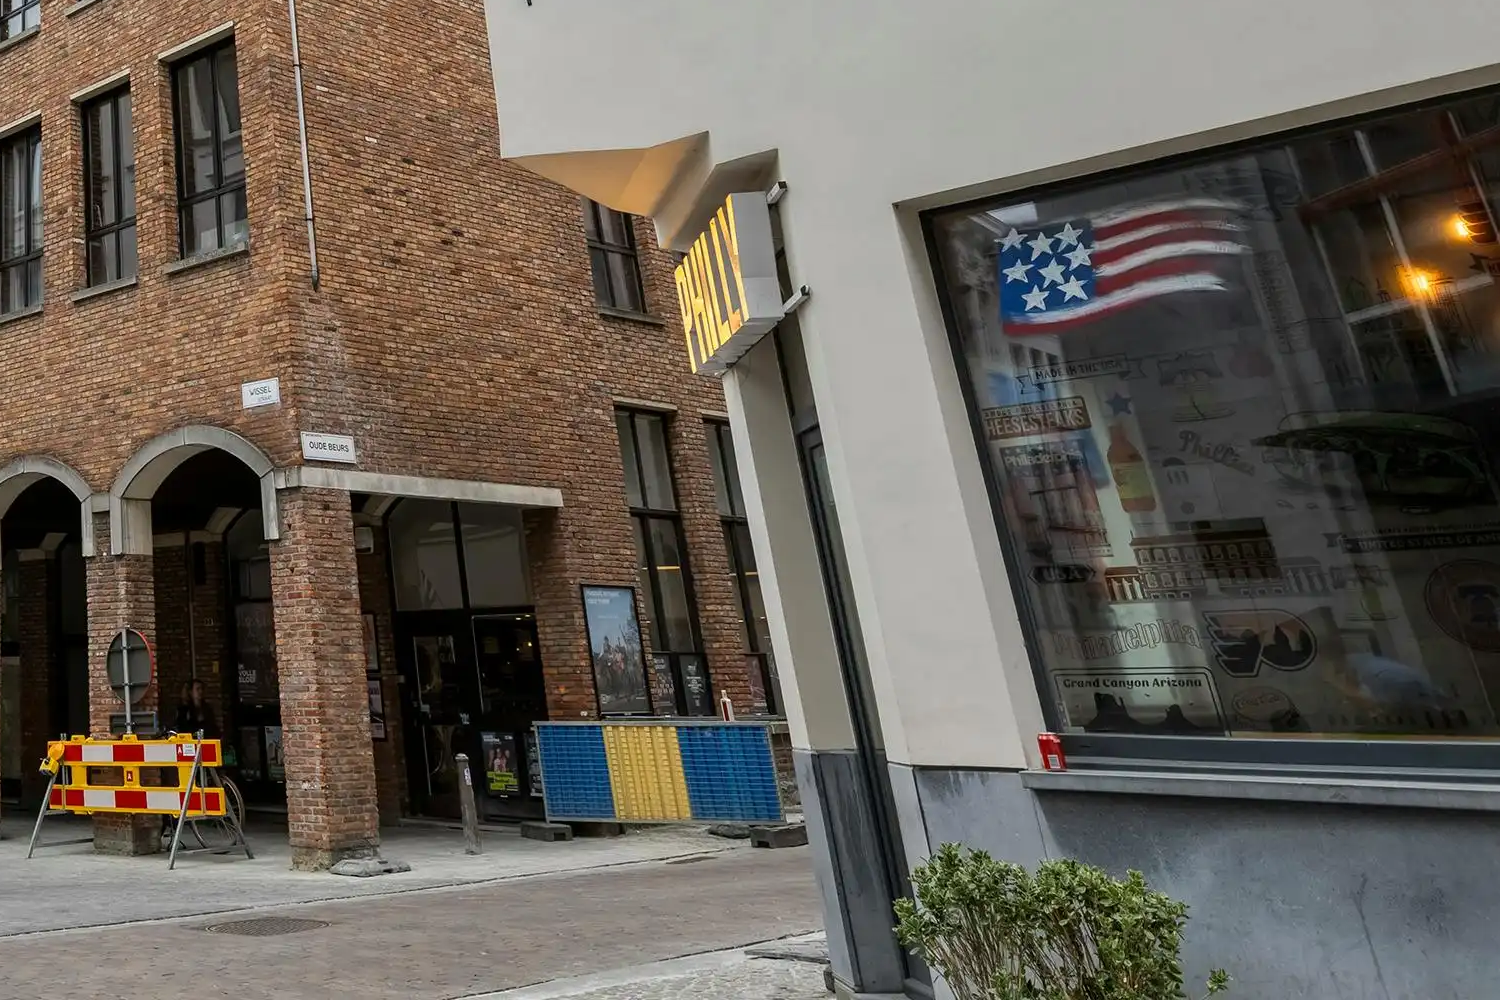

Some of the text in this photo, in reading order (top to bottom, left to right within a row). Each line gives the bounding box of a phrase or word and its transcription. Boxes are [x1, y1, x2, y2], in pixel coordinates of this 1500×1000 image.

[675, 194, 749, 374] PHILLY
[1036, 360, 1123, 380] MADE IN THE USA
[249, 386, 271, 395] WISSEL
[988, 409, 1083, 435] HEESESTEAKS
[309, 441, 349, 452] OUDE BEURS
[1358, 539, 1402, 549] UNITED
[1407, 536, 1451, 547] STATES
[1053, 619, 1202, 660] Philadelphia
[1063, 677, 1202, 689] Grand Canyon Arizona
